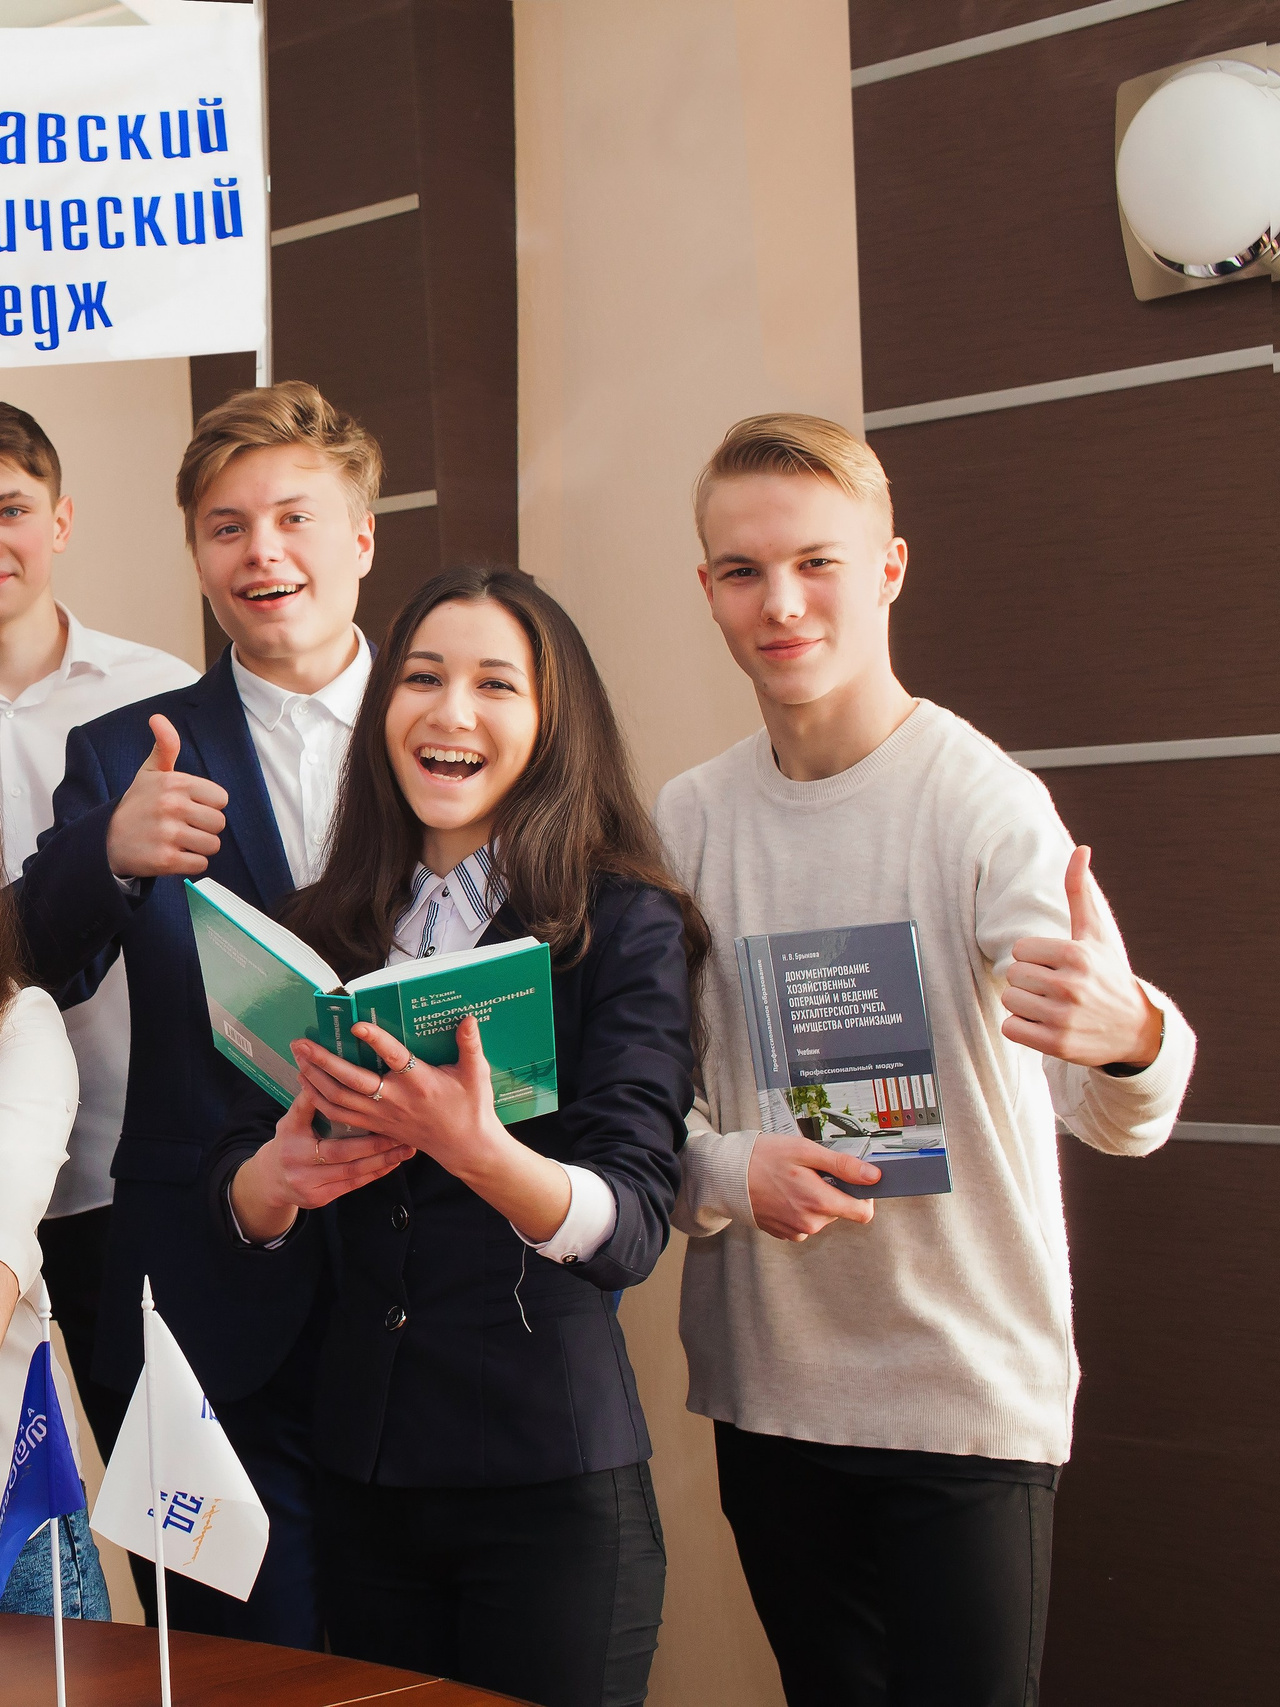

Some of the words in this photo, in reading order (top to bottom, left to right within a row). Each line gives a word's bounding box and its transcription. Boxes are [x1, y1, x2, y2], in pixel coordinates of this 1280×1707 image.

[785, 962, 870, 983] ДОКУМЕНТИРОВАНИЕ
[786, 978, 857, 995] ХОЗЯЙСТВЕННЫХ
[413, 986, 536, 1023] ИНФОРМАЦИОННЫЕ
[788, 992, 831, 1008] ОПЕРАЦИЙ
[833, 993, 840, 1003] И
[841, 988, 879, 1003] ВЕДЕНИЕ
[790, 1004, 860, 1021] БУХГАЛТЕРСКОГО
[861, 1001, 887, 1014] УЧЕТА
[792, 1019, 843, 1034] ИМУЩЕСТВА
[844, 1013, 903, 1029] ОРГАНИЗАЦИИ
[799, 1063, 873, 1077] Профессиональный
[875, 1061, 904, 1070] модуль
